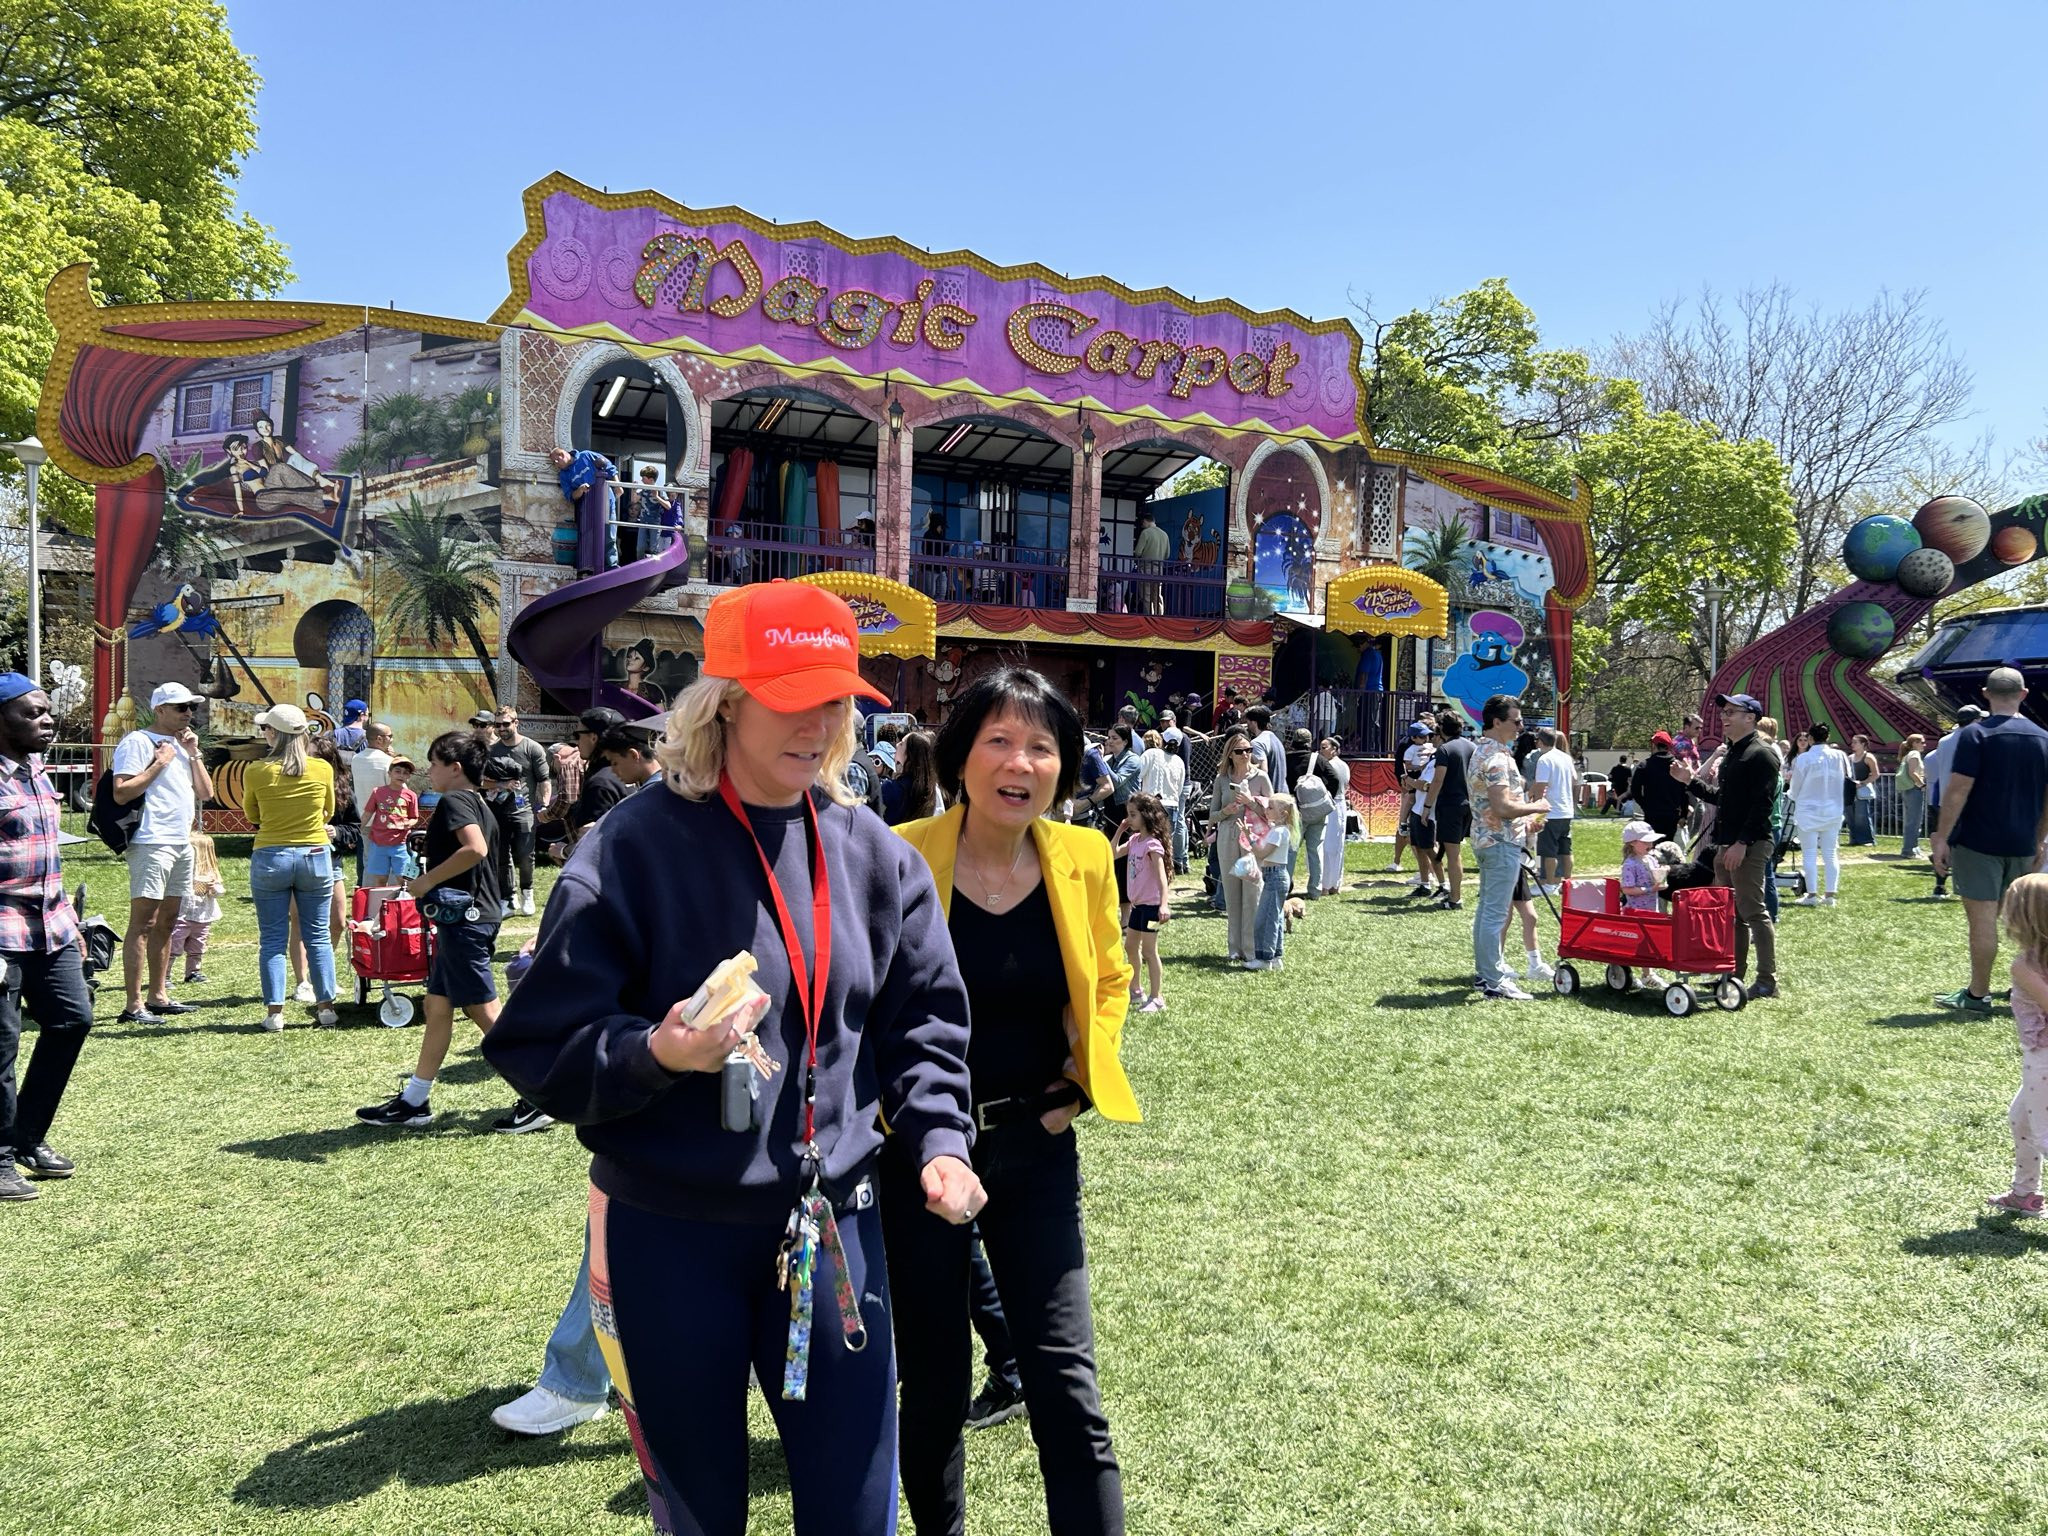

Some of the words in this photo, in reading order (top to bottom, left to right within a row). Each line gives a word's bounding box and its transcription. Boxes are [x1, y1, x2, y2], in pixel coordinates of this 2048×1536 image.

[634, 233, 978, 350] Magic
[1007, 302, 1299, 399] Carpet
[1364, 590, 1408, 607] Magic
[1373, 598, 1413, 617] Carpet
[857, 610, 887, 628] rpet
